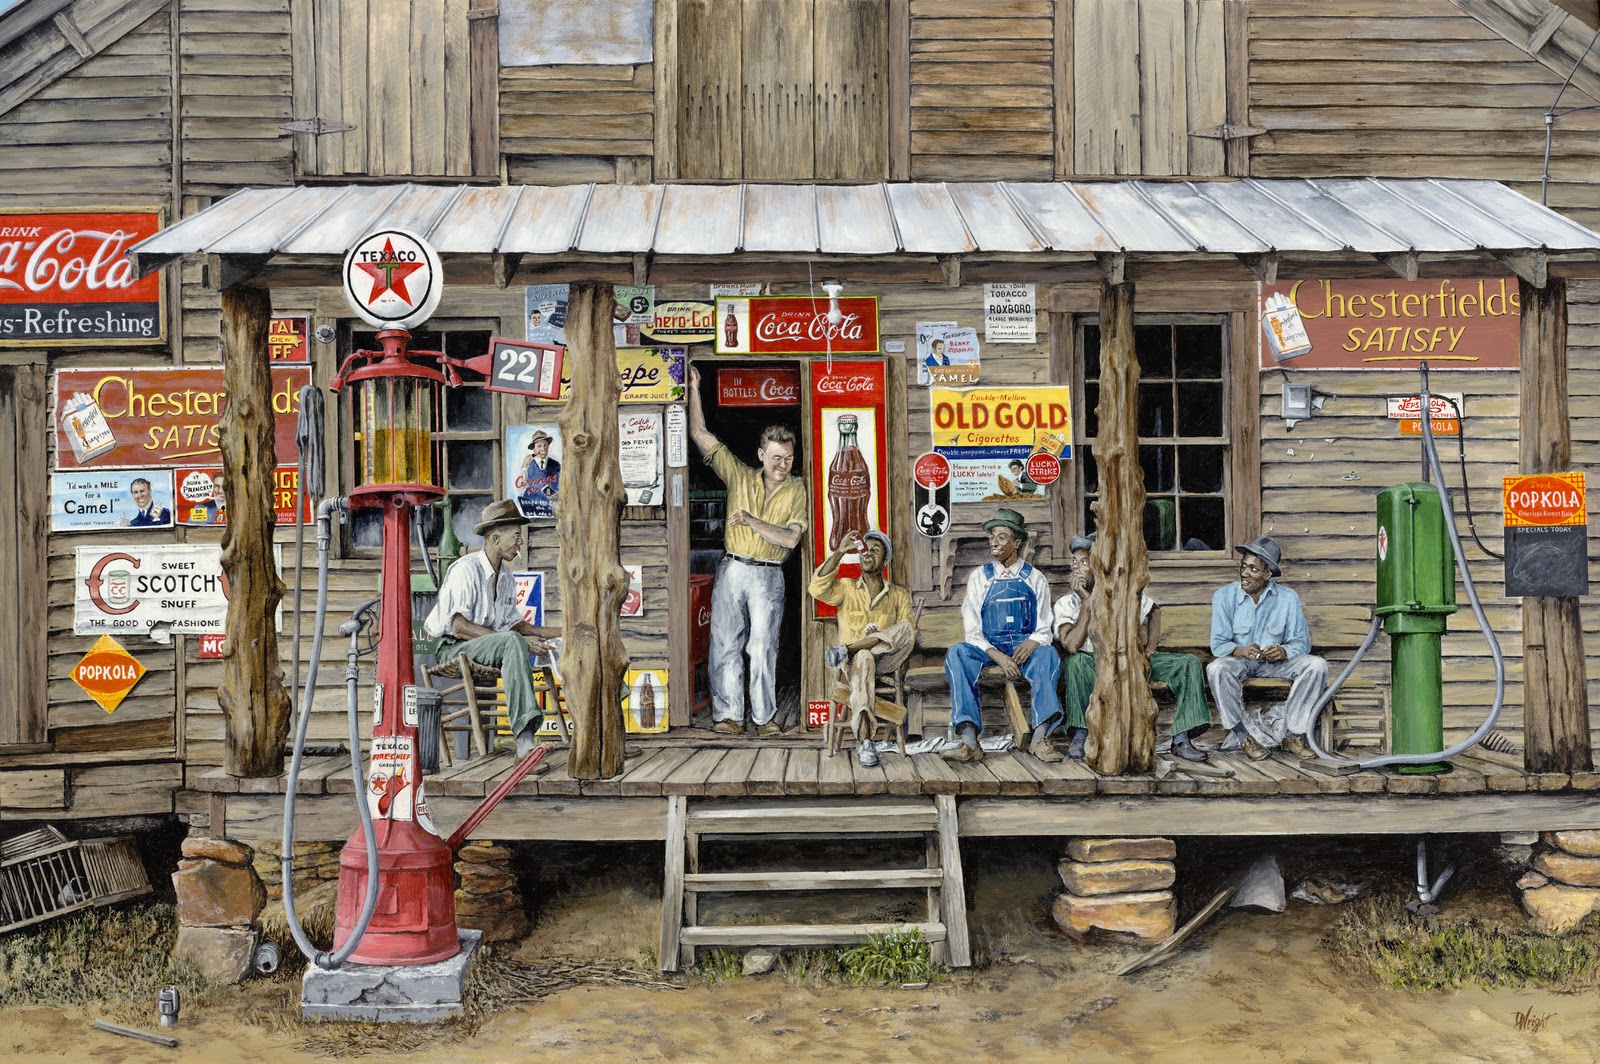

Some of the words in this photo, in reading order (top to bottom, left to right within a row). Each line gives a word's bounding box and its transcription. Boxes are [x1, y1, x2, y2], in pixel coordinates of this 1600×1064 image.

[0, 226, 43, 237] RINK
[0, 228, 138, 292] a-Cola
[360, 250, 416, 262] TEXACO
[1290, 279, 1520, 318] Chesterfields
[990, 304, 1030, 314] ROXBORO
[0, 308, 154, 335] s-Refreshing
[270, 320, 300, 334] TAL
[646, 310, 714, 329] hero-Col
[1342, 326, 1466, 352] SATISFY
[498, 349, 538, 384] 22
[621, 363, 660, 392] ape
[733, 377, 742, 386] IN
[816, 376, 874, 393] Coca-Cola
[93, 376, 301, 418] Chesterds
[724, 388, 757, 398] BOTTLES
[934, 402, 989, 430] OLD
[994, 402, 1068, 430] GOLD
[1412, 422, 1454, 432] POKOLA
[144, 424, 221, 450] SATIS
[967, 432, 1020, 446] Cigarettes
[916, 466, 948, 476] Coca-Cola
[1029, 468, 1058, 476] STRIKE
[182, 484, 212, 494] PRINCELY
[1510, 490, 1580, 508] POPKOLA
[137, 574, 215, 593] SCOTCH
[161, 600, 197, 608] SNUFF
[172, 619, 220, 627] FASHIONE
[79, 665, 137, 681] POPKOLA
